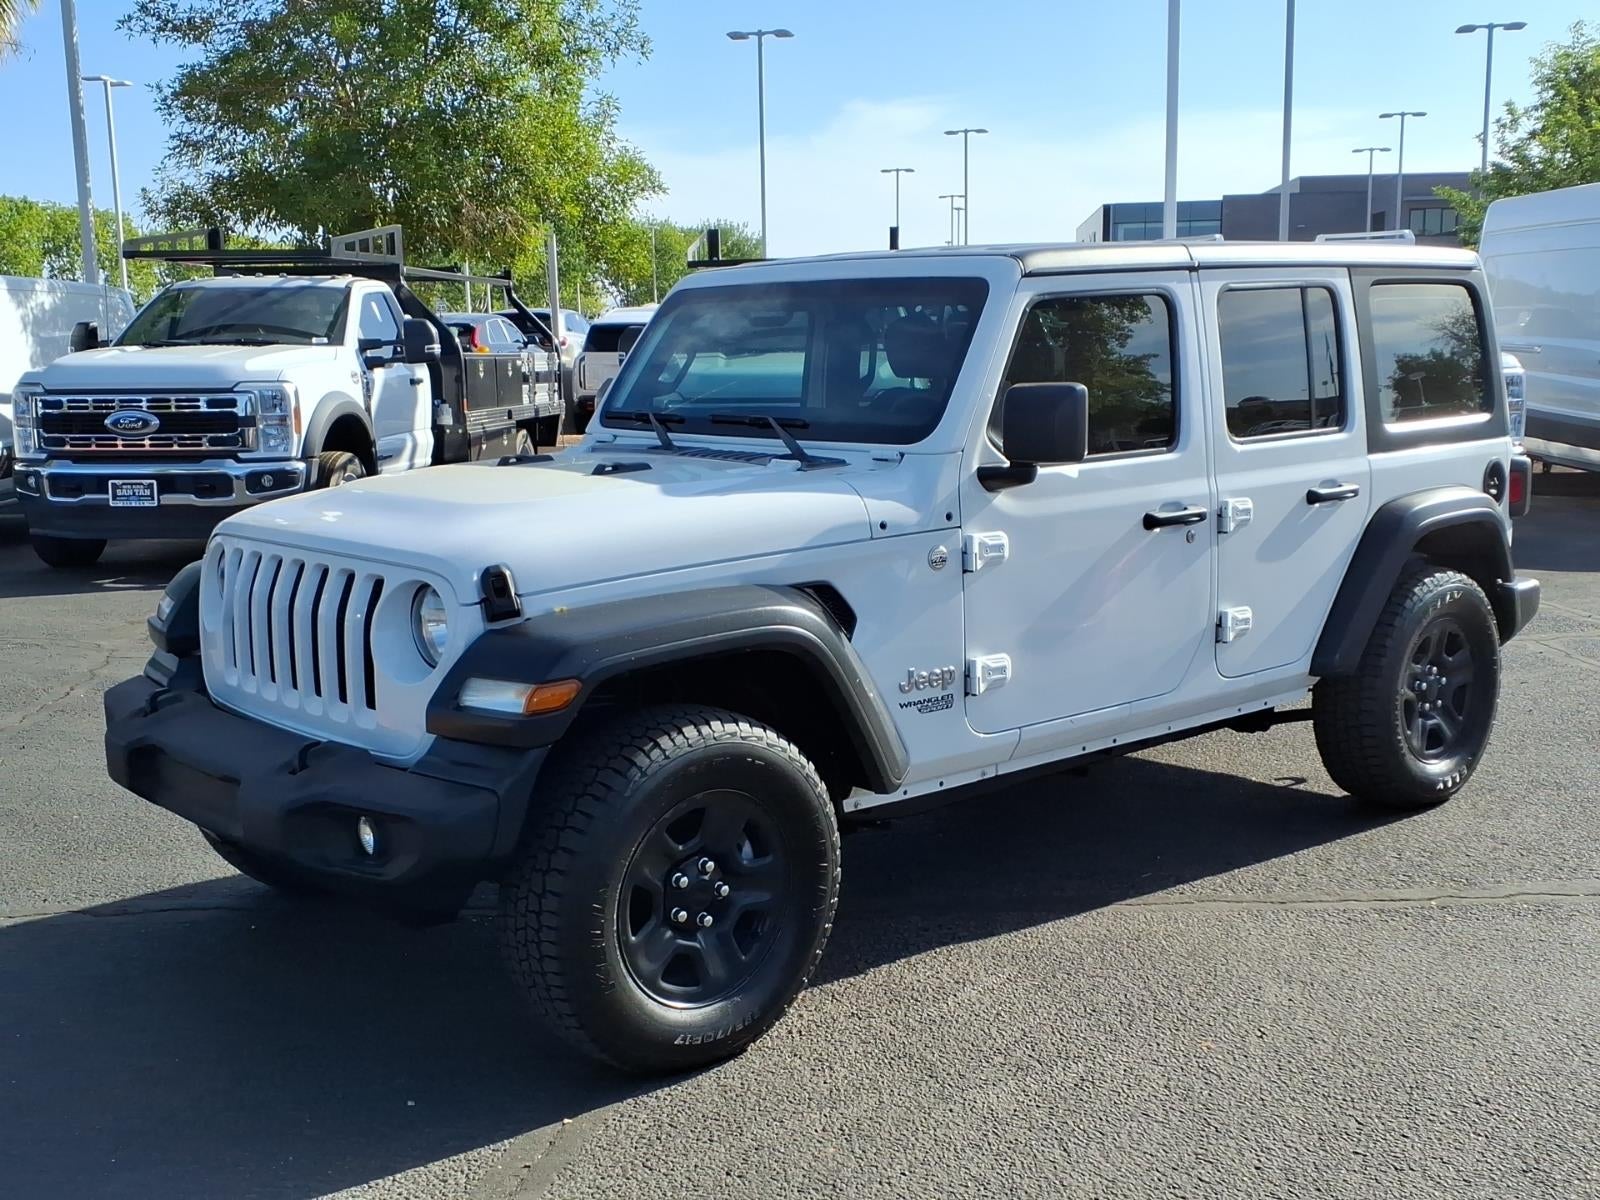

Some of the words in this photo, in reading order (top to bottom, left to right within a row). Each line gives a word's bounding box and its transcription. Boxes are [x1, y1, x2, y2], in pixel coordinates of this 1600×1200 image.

[117, 417, 144, 429] Ford
[898, 665, 956, 694] Jeep
[898, 693, 954, 709] WRANGLER
